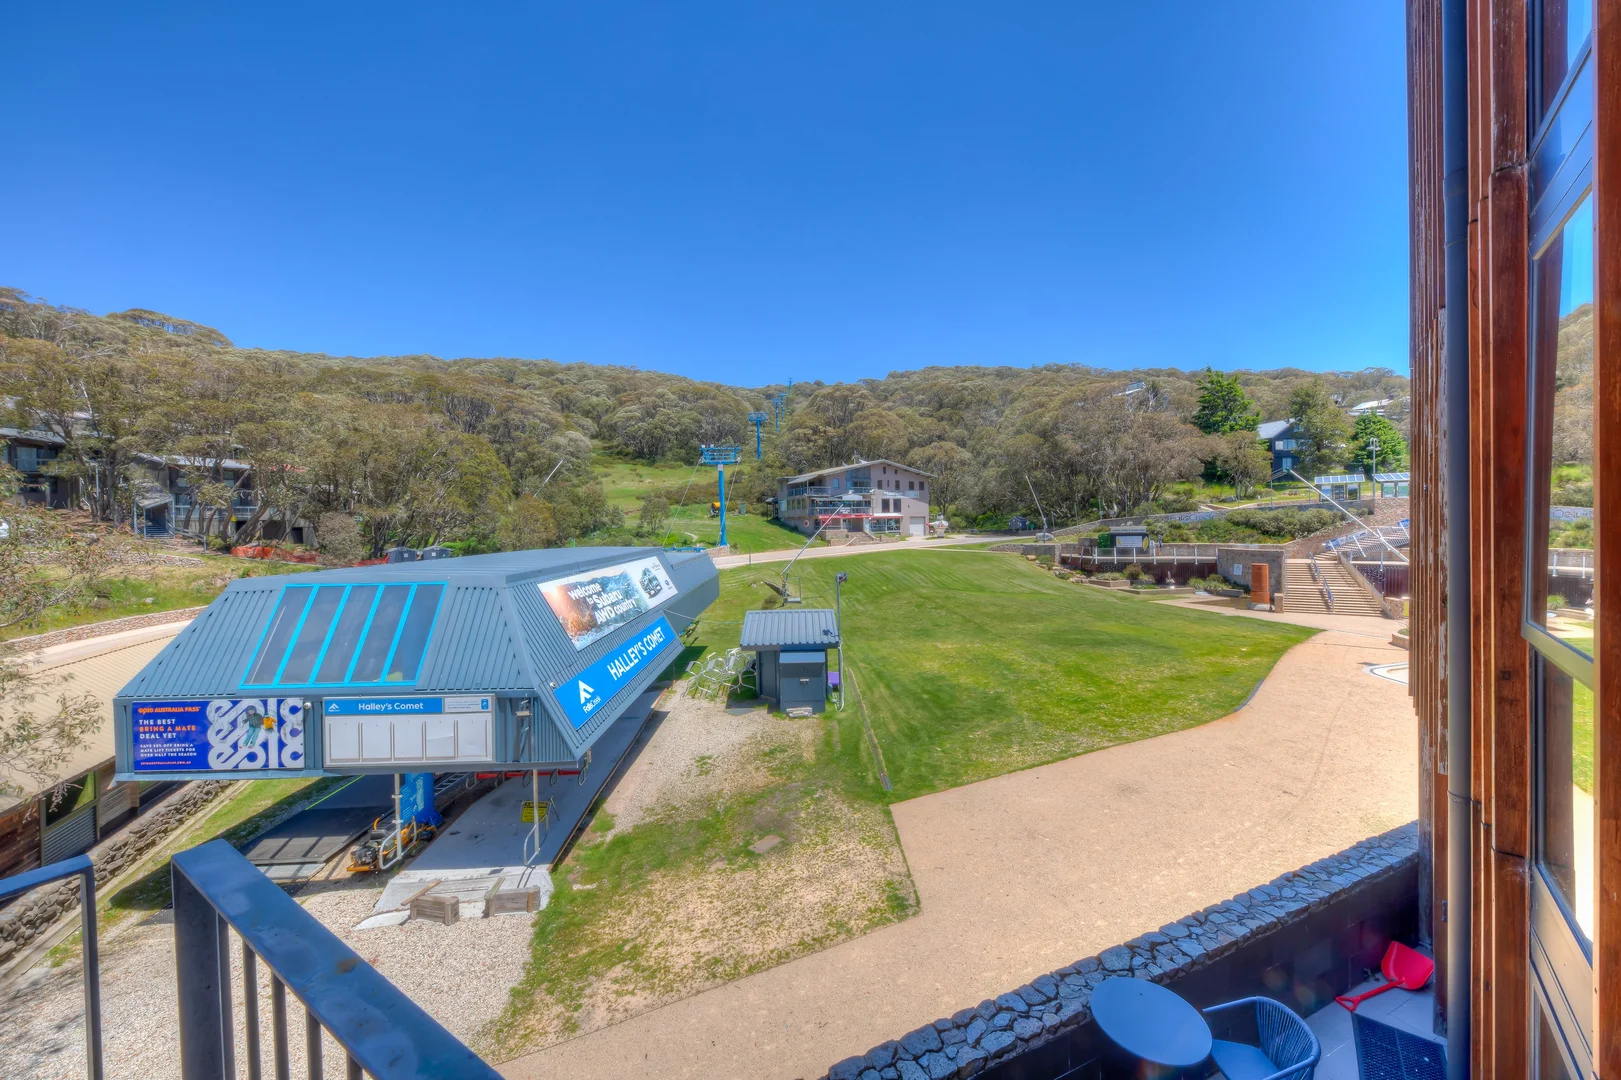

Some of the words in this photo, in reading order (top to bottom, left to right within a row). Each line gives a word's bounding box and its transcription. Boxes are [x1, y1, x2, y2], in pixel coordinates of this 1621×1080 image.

[567, 583, 602, 600] welcome
[592, 590, 623, 608] Subaru
[594, 606, 616, 624] AWD
[613, 598, 637, 615] country
[606, 642, 647, 680] HALLEY'S
[643, 626, 666, 651] COMET
[358, 702, 392, 712] Halley's
